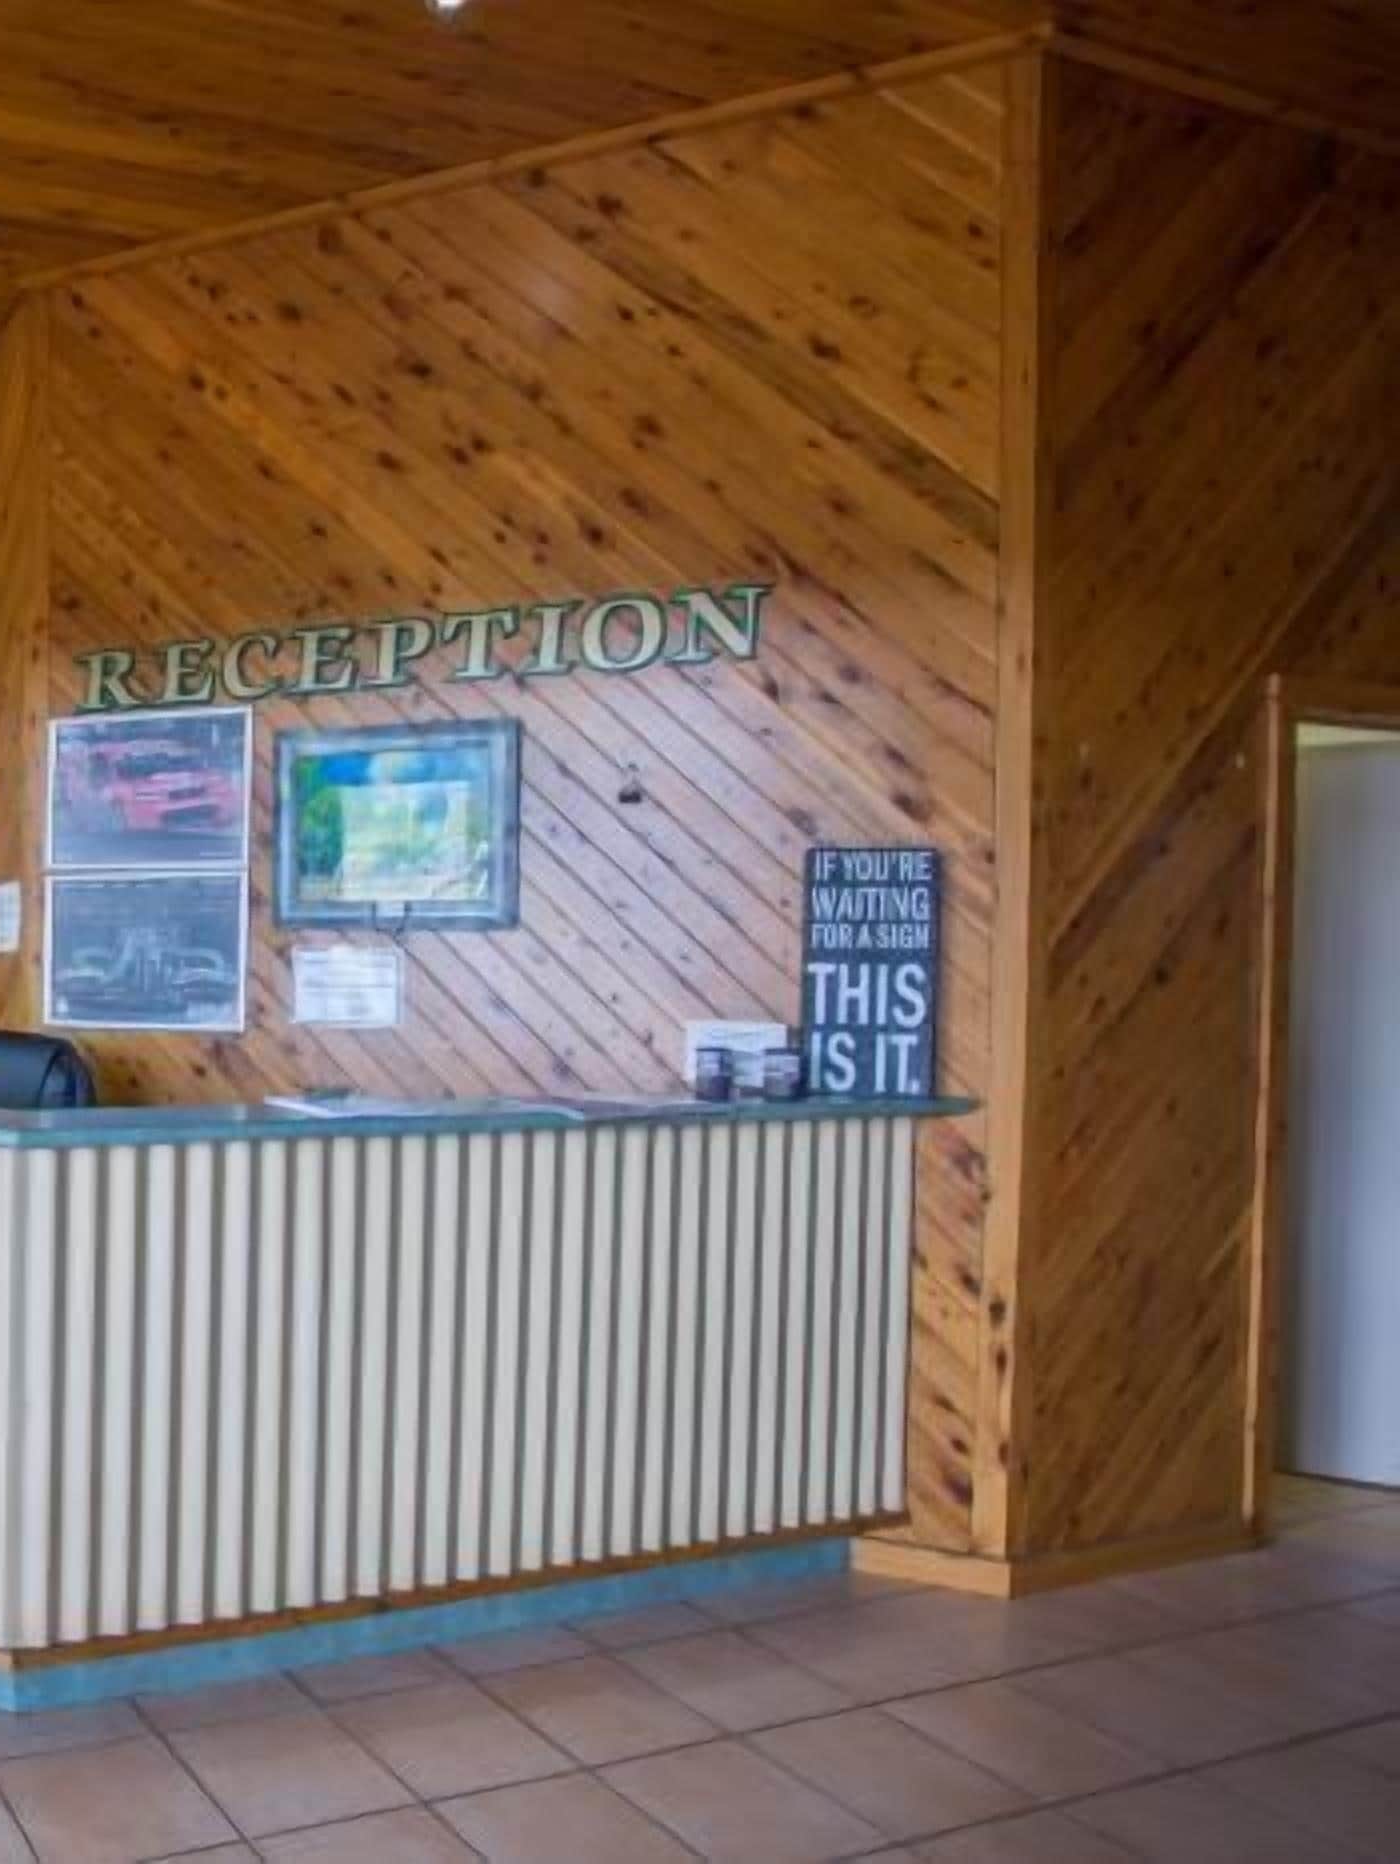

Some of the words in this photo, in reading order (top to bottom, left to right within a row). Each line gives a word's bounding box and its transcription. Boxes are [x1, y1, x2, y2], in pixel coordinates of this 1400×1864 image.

[72, 583, 773, 713] RECEPTION
[814, 851, 838, 880] IF
[843, 852, 933, 880] YOU'RE
[810, 886, 931, 921] WAITING
[811, 923, 853, 949] FOR
[854, 923, 874, 949] A
[877, 923, 930, 949] SIGN
[807, 962, 927, 1028] THIS
[810, 1031, 857, 1092] IS
[873, 1032, 921, 1094] IT.
